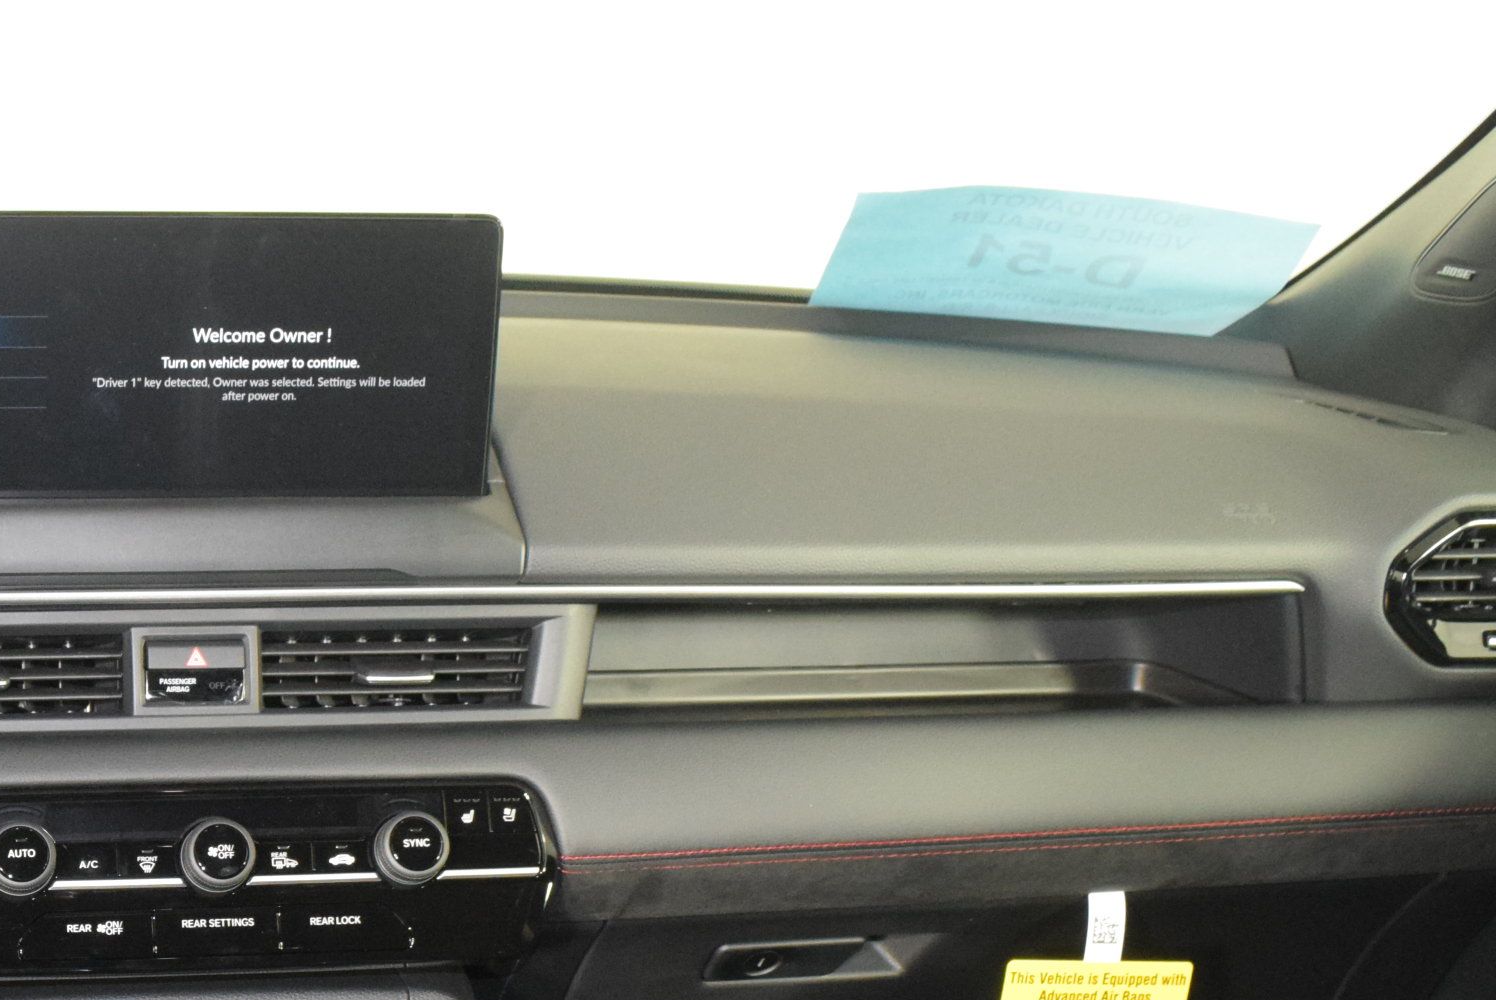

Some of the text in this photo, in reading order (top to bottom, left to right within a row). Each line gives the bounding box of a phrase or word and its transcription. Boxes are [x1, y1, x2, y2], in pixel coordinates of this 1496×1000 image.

[192, 327, 333, 344] Welcome Owner !
[160, 356, 361, 371] Turn on vehicle power to continue.
[92, 376, 427, 390] "Driver 1" key detected, Owner was selected. Settings will be loaded
[221, 391, 297, 403] after power on.
[159, 677, 197, 685] PASSENGER
[208, 681, 224, 690] OFF
[217, 843, 235, 852] ON/
[402, 837, 431, 849] SYNC
[7, 848, 36, 859] AUTO
[217, 851, 235, 860] OFF
[270, 851, 288, 859] REAR
[136, 855, 158, 863] FRONT
[78, 860, 99, 869] A/C
[181, 917, 255, 929] REAR SETTINGS
[309, 915, 362, 926] REAR LOCK
[66, 923, 92, 933] REAR
[106, 928, 123, 936] OFF
[1010, 971, 1187, 988] This Vehicle is Equipped with
